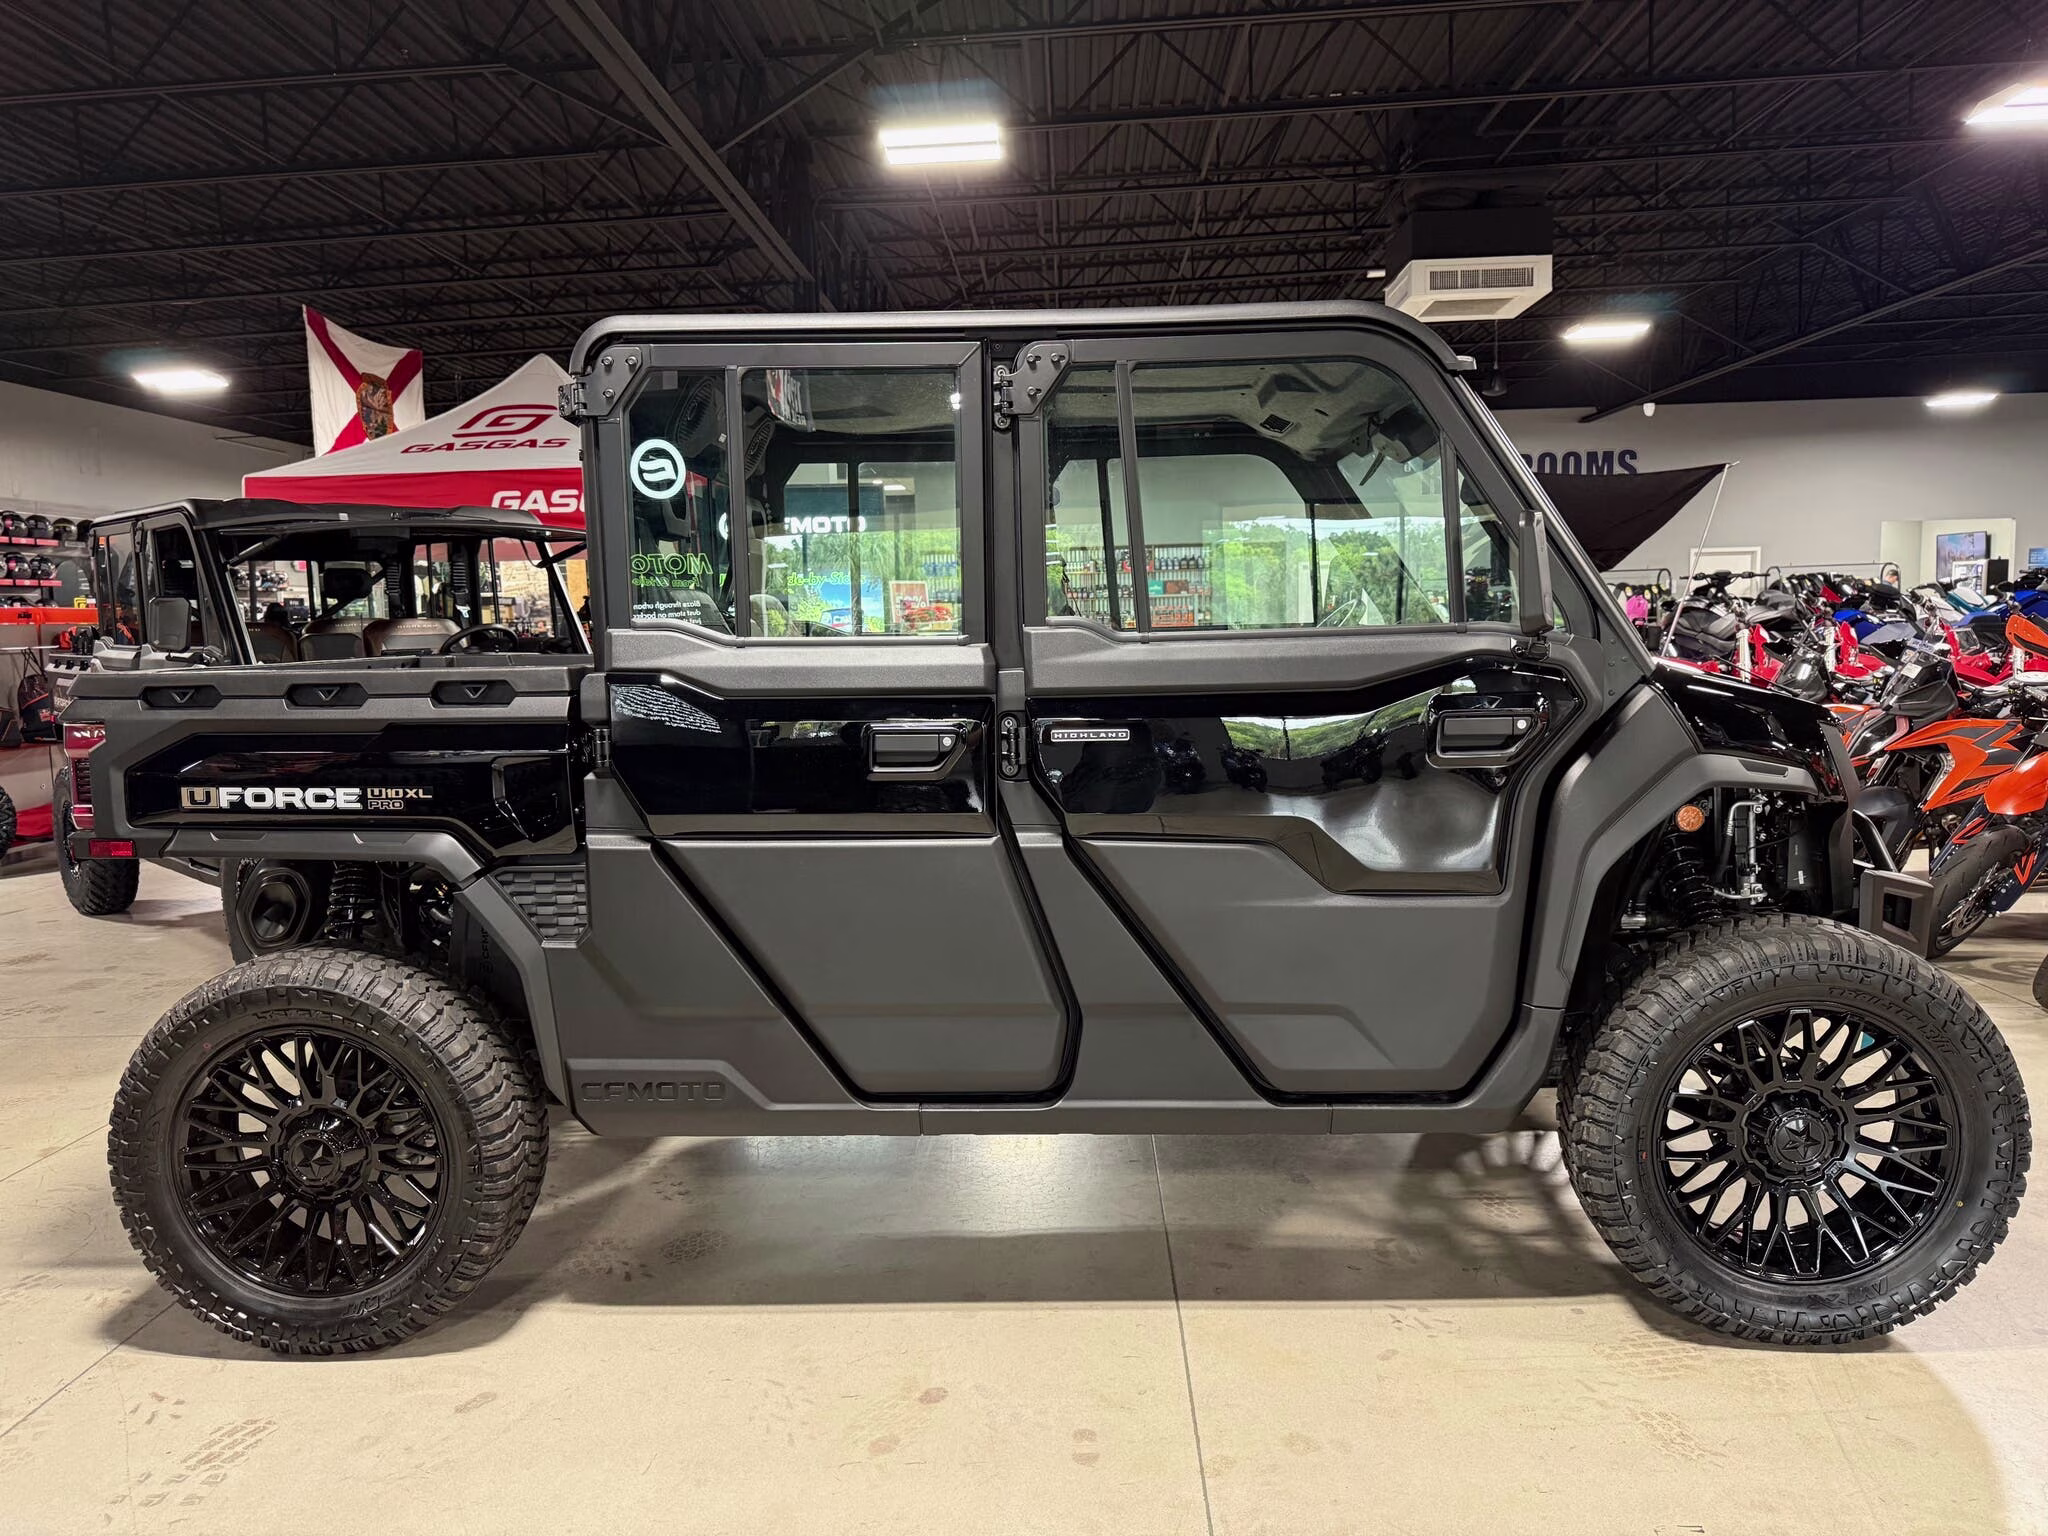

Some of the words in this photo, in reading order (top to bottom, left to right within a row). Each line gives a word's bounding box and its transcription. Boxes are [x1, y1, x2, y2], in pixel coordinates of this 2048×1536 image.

[400, 438, 571, 455] GASGAS
[491, 488, 584, 513] GAS
[181, 786, 363, 810] UFORCE
[368, 799, 404, 810] PRO
[580, 1082, 726, 1102] CFMOTO
